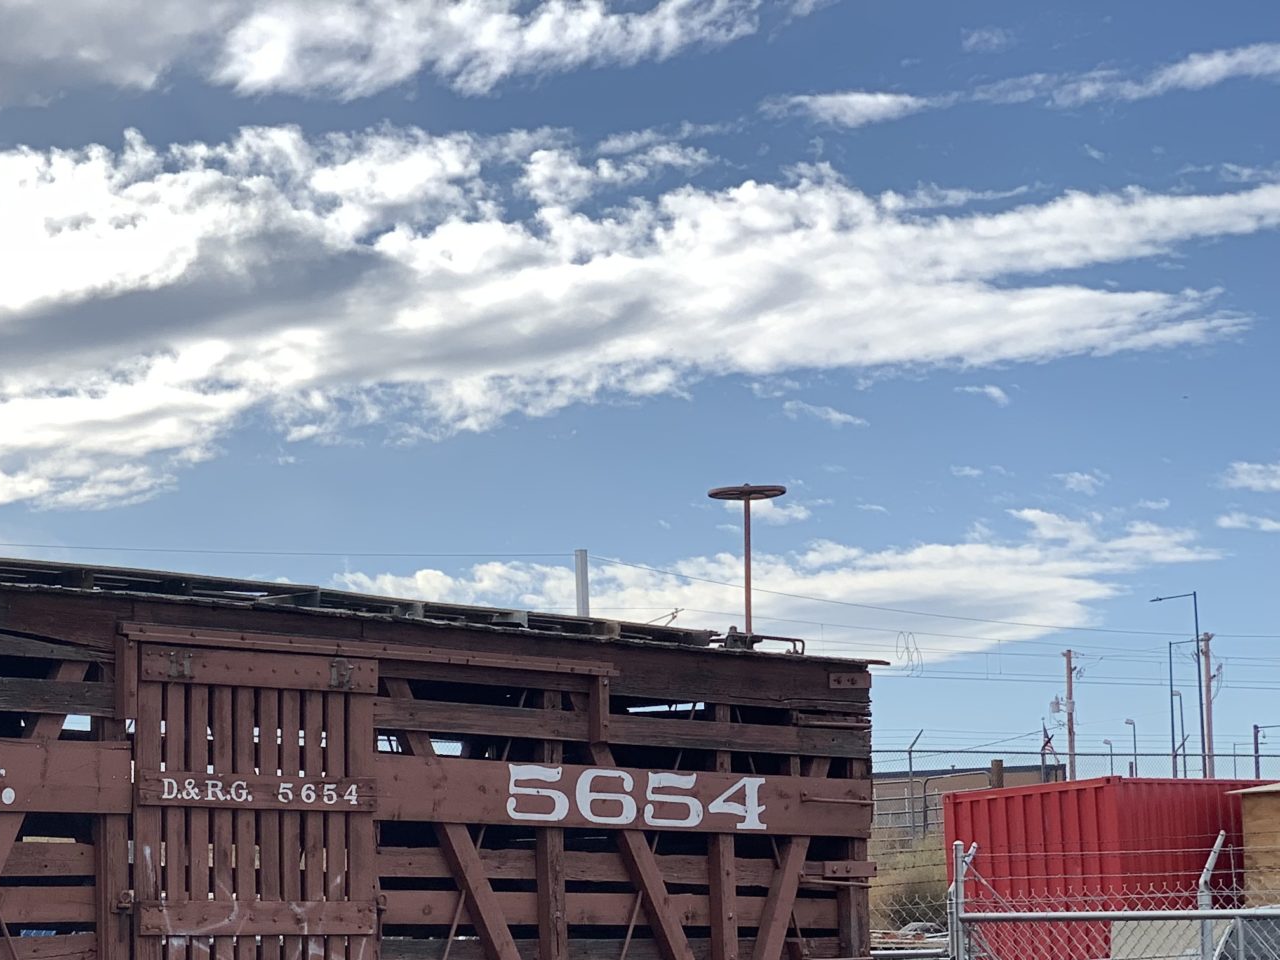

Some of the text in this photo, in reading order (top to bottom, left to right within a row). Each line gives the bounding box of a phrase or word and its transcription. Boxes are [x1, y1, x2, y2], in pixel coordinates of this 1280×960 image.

[161, 778, 358, 805] D.&R.G. 5654
[506, 763, 767, 830] 5654
